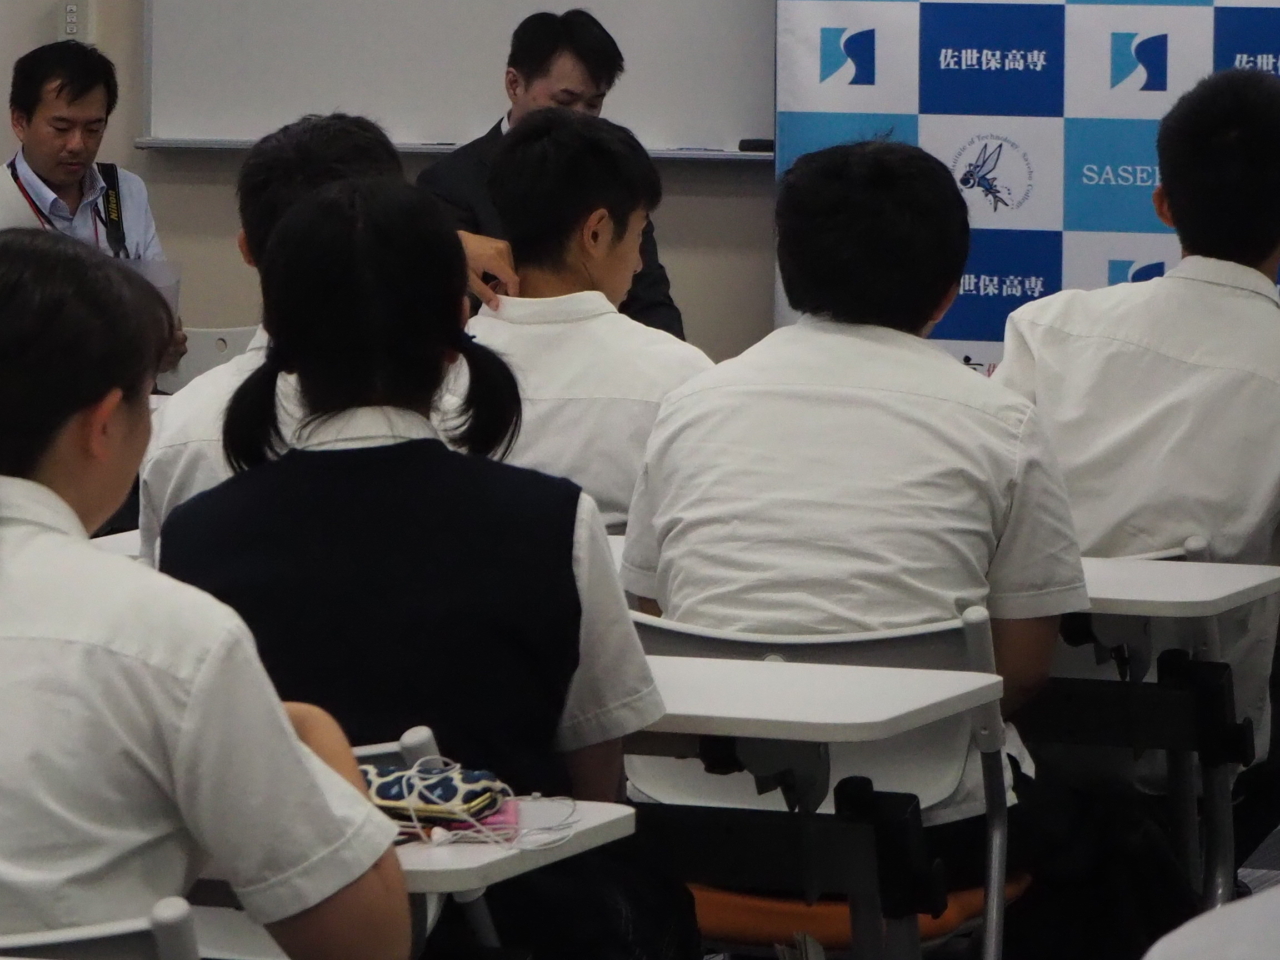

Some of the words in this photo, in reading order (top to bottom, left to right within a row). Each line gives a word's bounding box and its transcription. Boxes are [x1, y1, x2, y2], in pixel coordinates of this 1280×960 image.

[939, 48, 1047, 71] 佐世保高専
[1234, 53, 1280, 76] 佐世
[1082, 164, 1161, 187] SASE
[107, 189, 119, 222] Nikon
[958, 273, 1045, 298] 世保高専
